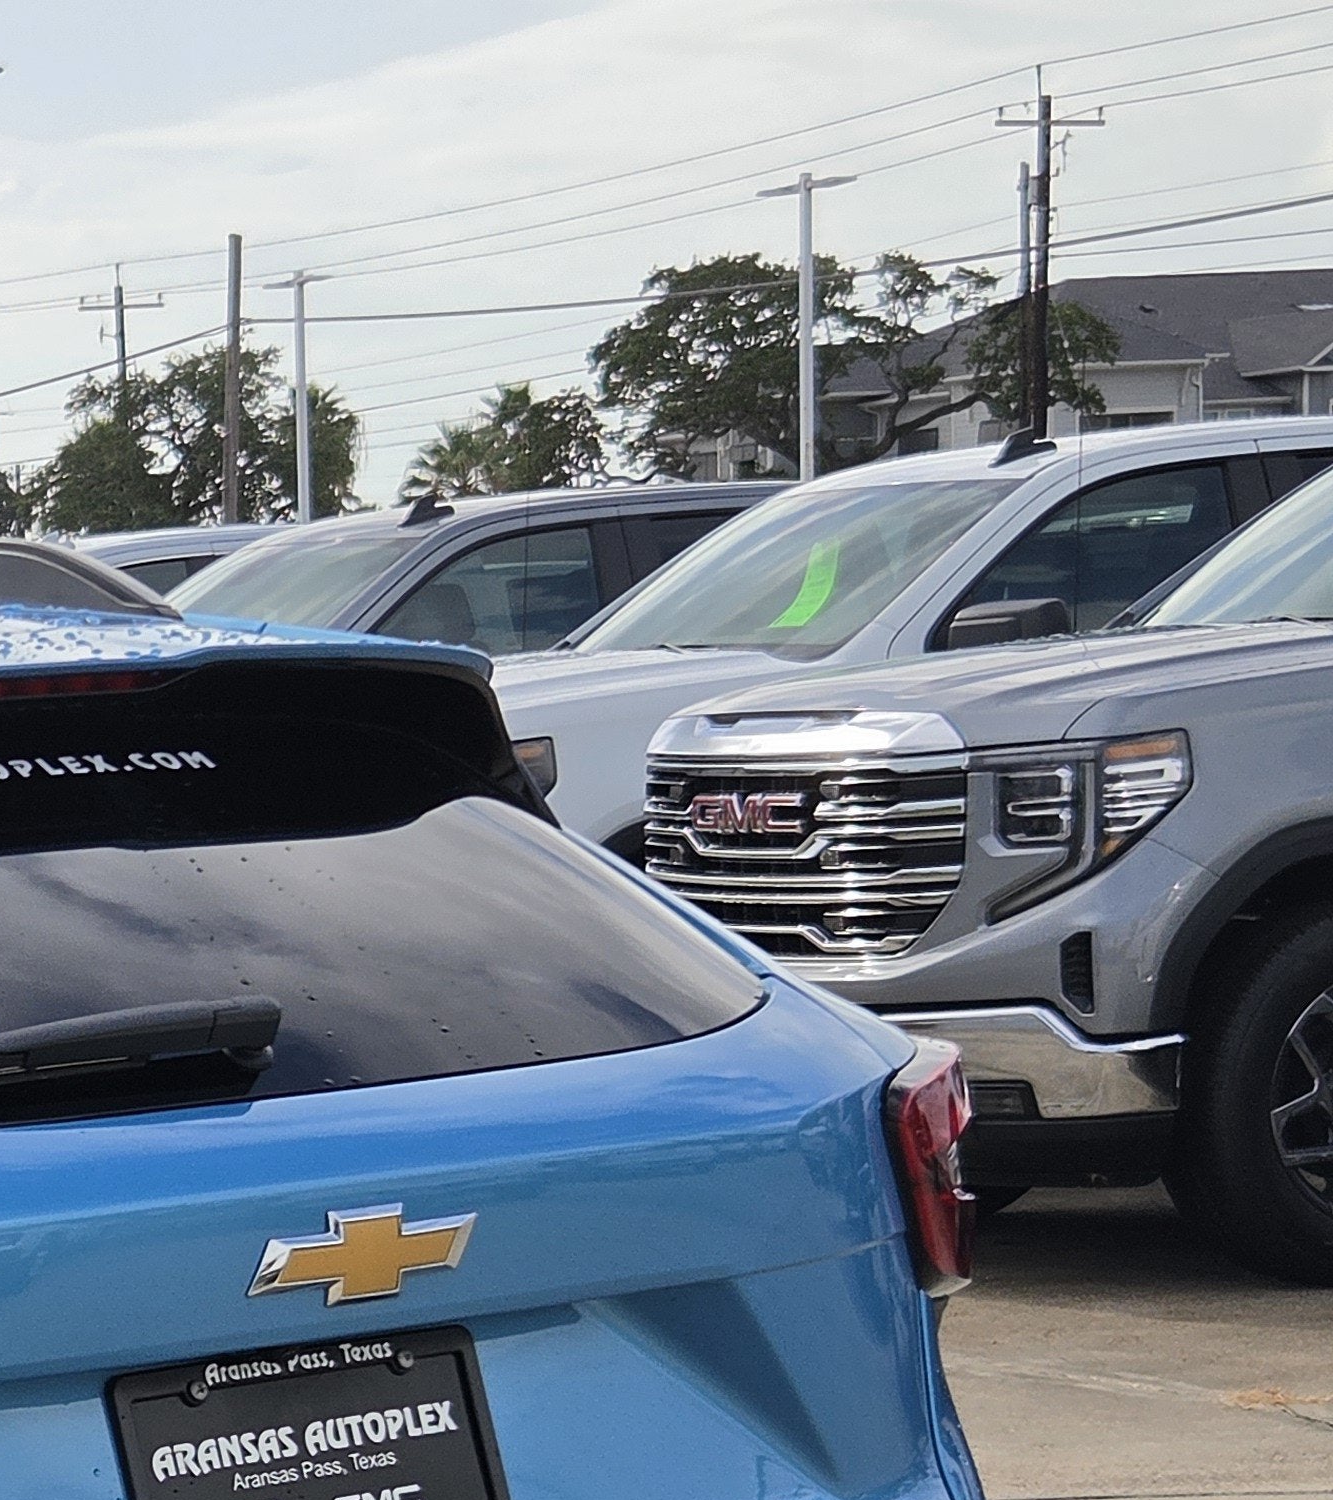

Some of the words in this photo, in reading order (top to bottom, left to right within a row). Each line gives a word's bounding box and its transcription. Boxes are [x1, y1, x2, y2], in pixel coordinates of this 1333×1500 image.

[691, 793, 804, 834] GMC
[204, 1362, 282, 1387] Aransas
[339, 1341, 393, 1364] Texas
[151, 1425, 299, 1483] ARANSAS
[304, 1400, 459, 1457] AUTOPLEX
[233, 1462, 299, 1491] Aransas
[302, 1456, 348, 1479] Pass,
[348, 1449, 397, 1472] Texas
